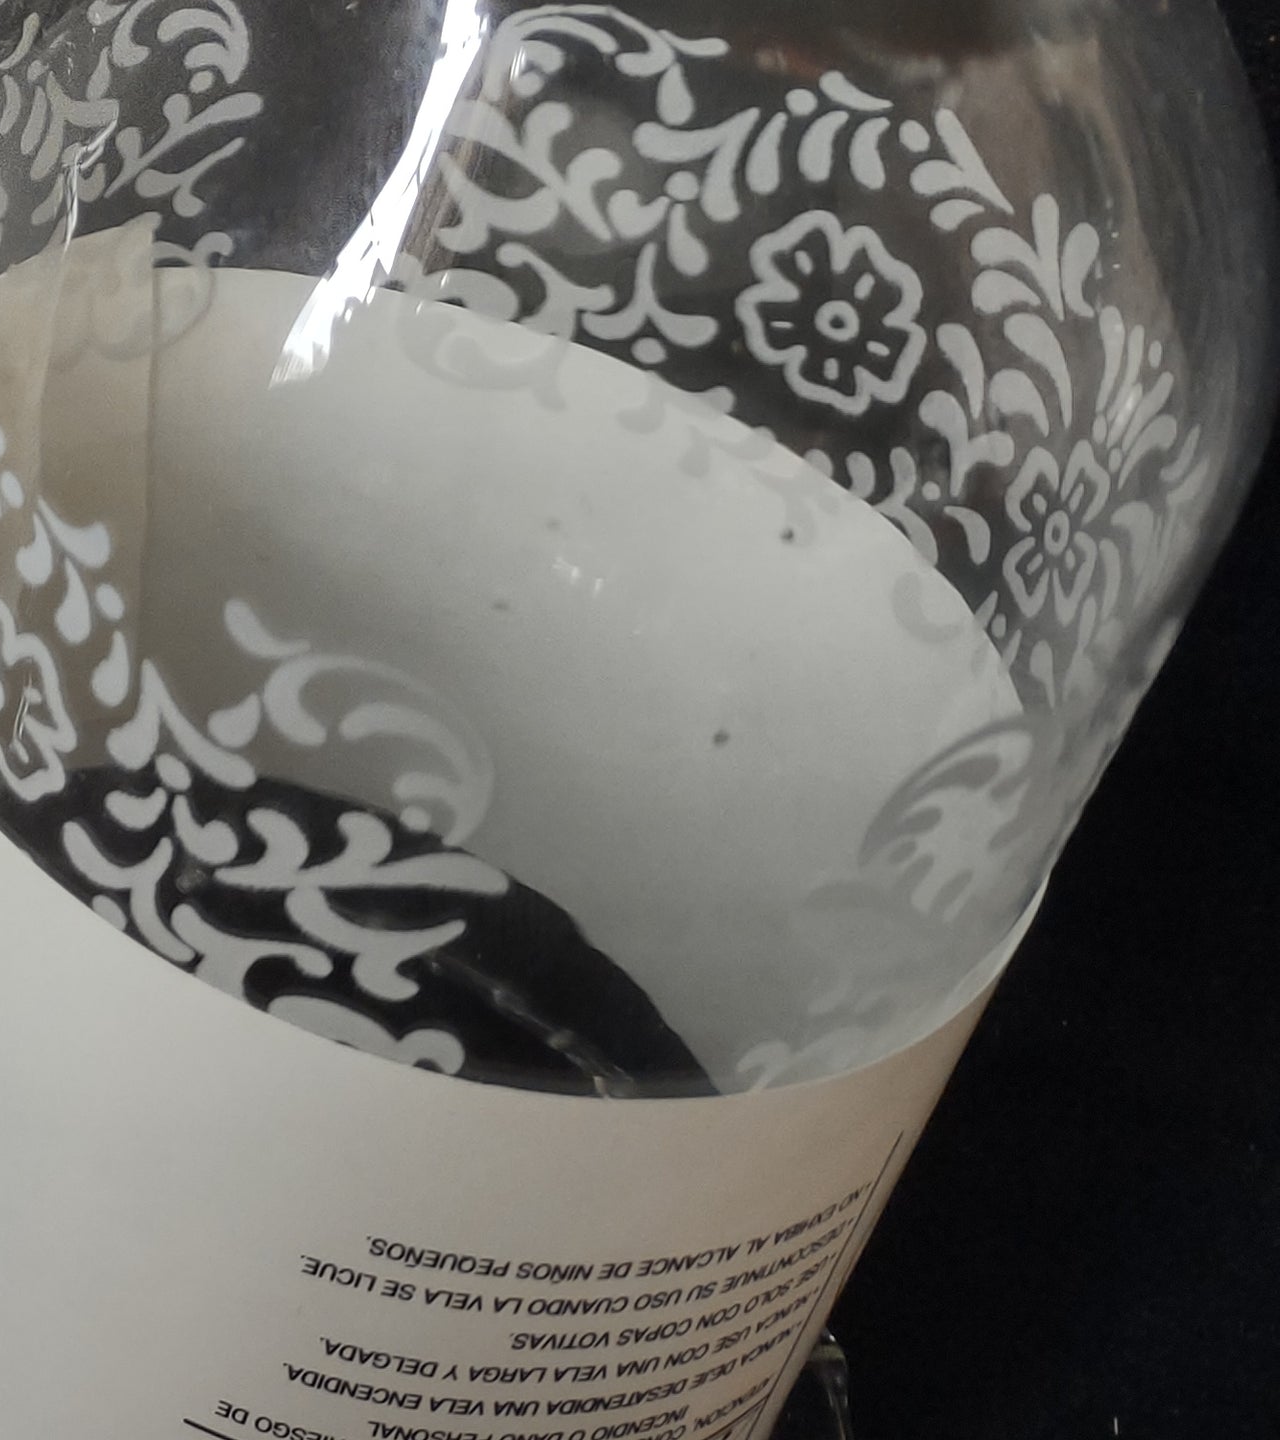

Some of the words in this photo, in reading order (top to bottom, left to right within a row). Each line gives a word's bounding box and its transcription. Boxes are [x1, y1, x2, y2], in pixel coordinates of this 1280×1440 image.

[838, 1186, 864, 1212] NO
[773, 1203, 838, 1246] EXHIBA
[365, 1236, 511, 1278] PEQUEÑOS.
[720, 1219, 847, 1294] DESCONTINUE
[746, 1234, 771, 1256] AL
[299, 1254, 378, 1292] LICUE.
[597, 1261, 633, 1281] DE
[635, 1243, 742, 1278] ALCANCE
[516, 1262, 595, 1286] NIÑOS
[380, 1279, 417, 1302] SE
[424, 1288, 483, 1313] VELA
[633, 1288, 683, 1312] USO
[686, 1281, 718, 1303] SU
[743, 1278, 794, 1314] SOLO
[493, 1296, 524, 1315] LA
[527, 1296, 630, 1317] CUANDO
[696, 1303, 741, 1330] CON
[755, 1296, 809, 1333] NUNCA
[509, 1332, 611, 1351] VOTIVAS.
[616, 1318, 694, 1347] COPAS
[713, 1325, 751, 1354] USE
[319, 1337, 439, 1379] DELGADA.
[664, 1342, 710, 1370] CON
[741, 1327, 793, 1367] NUNCA
[441, 1364, 459, 1381] Y
[469, 1366, 548, 1383] LARGA
[554, 1365, 609, 1383] VELA
[616, 1357, 660, 1378] UNA
[689, 1358, 737, 1390] DEJE
[282, 1362, 423, 1411] ENCENDIDA.
[547, 1379, 688, 1416] DESATENDIDA
[214, 1399, 250, 1426] DE
[430, 1397, 485, 1416] VELA
[494, 1400, 540, 1417] UNA
[254, 1416, 345, 1440] ESGO
[591, 1404, 690, 1440] INCENDIO
